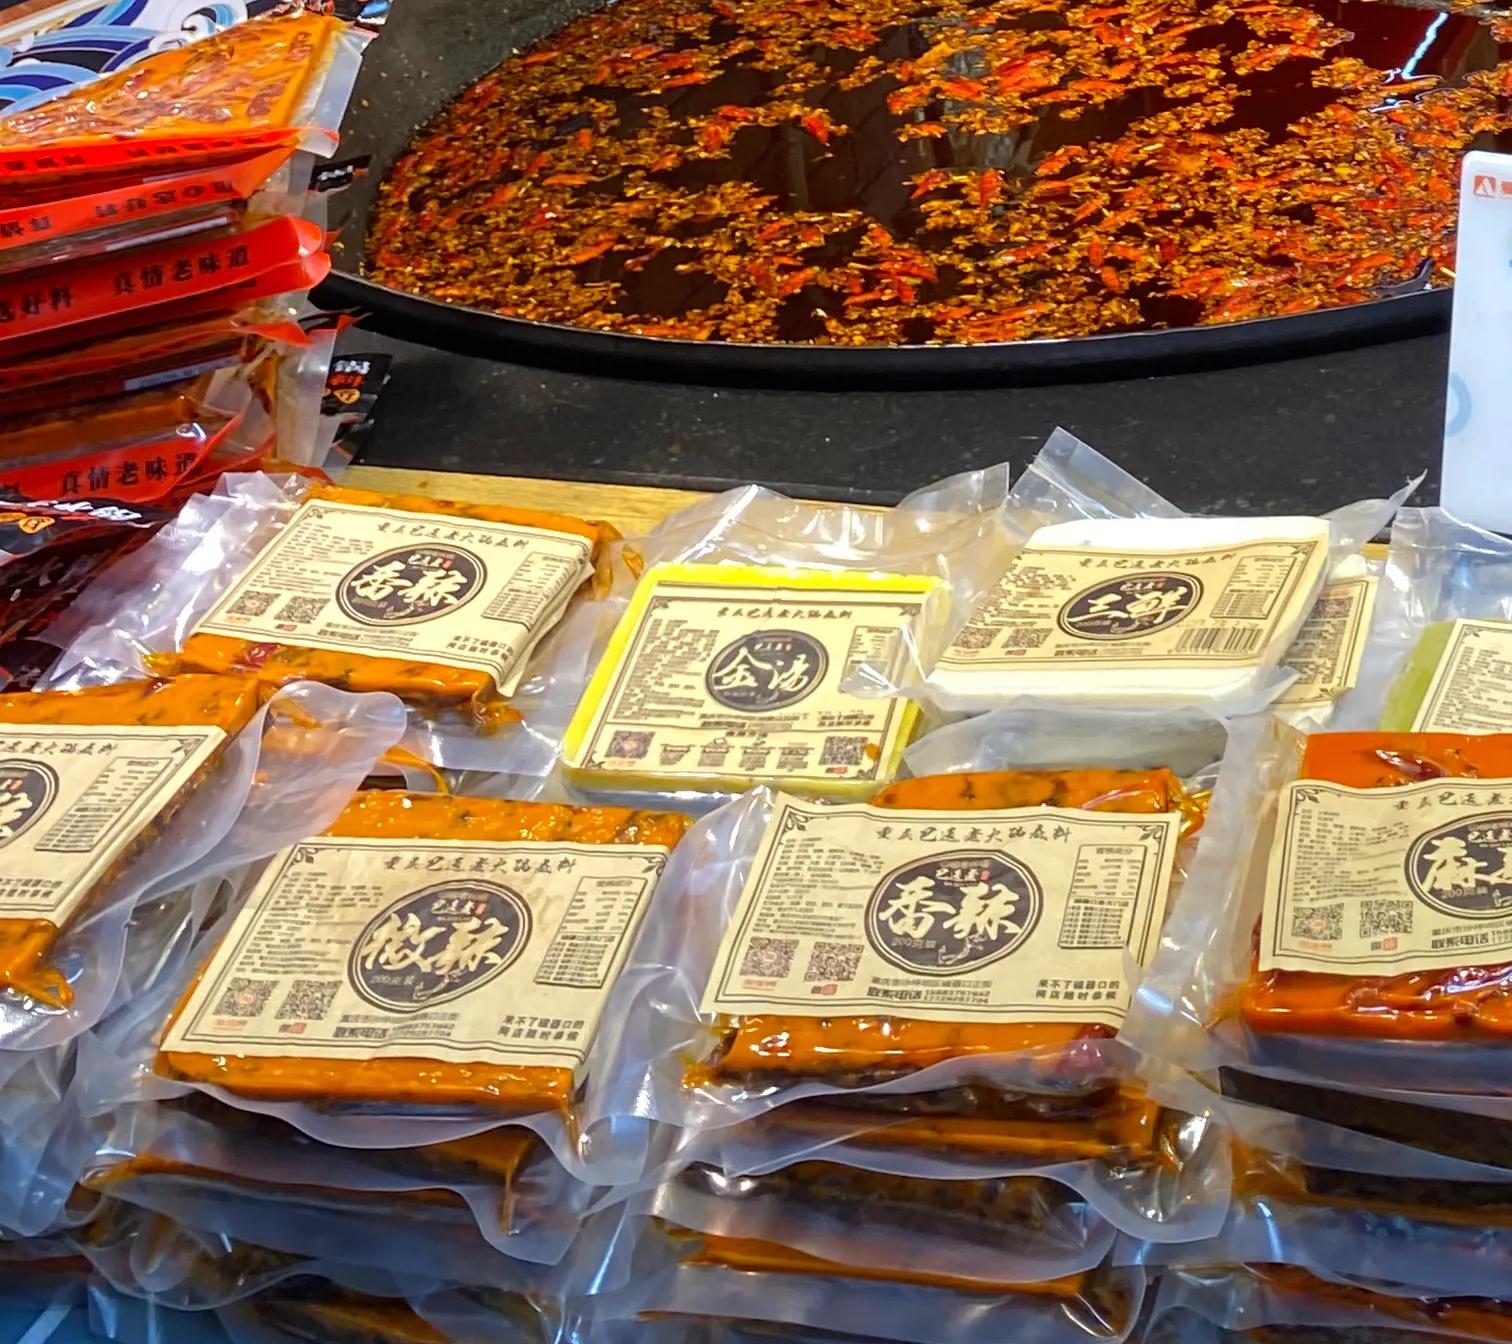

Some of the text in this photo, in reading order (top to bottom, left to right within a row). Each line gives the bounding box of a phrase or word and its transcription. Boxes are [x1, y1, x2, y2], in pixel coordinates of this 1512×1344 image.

[712, 646, 810, 693] 金汤
[876, 824, 1072, 844] 重庆巴适老火锅底料
[879, 876, 1022, 941] 香辣
[361, 913, 510, 974] 微辣
